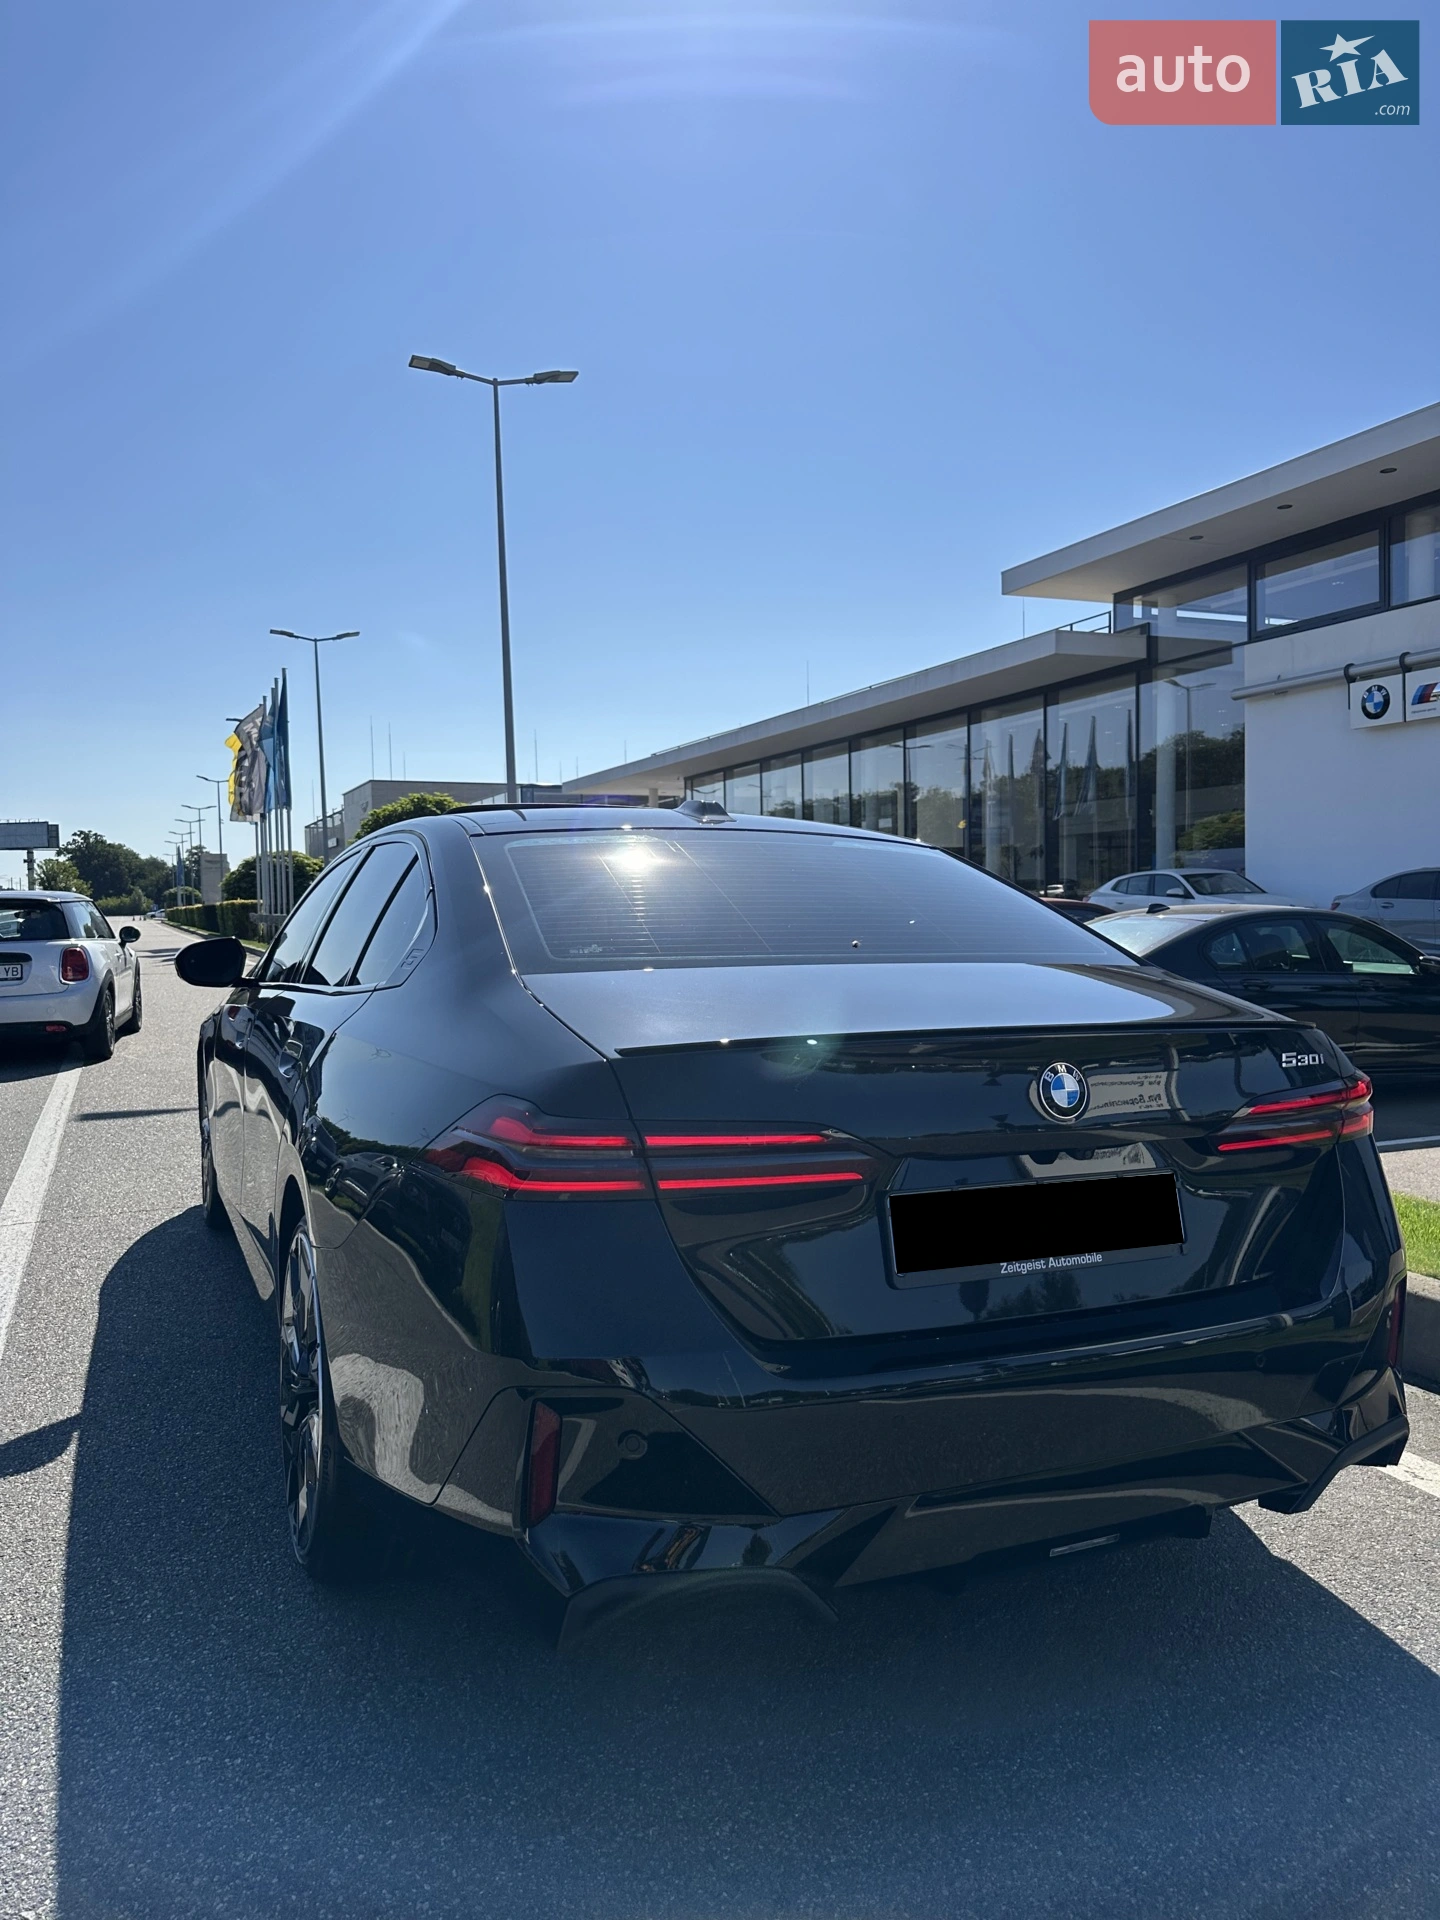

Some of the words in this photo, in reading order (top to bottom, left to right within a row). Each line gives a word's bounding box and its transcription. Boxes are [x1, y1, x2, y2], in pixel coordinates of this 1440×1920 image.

[1043, 1064, 1081, 1082] BMW
[1000, 1259, 1047, 1275] Zeitgeist
[1048, 1252, 1103, 1269] Automobile
